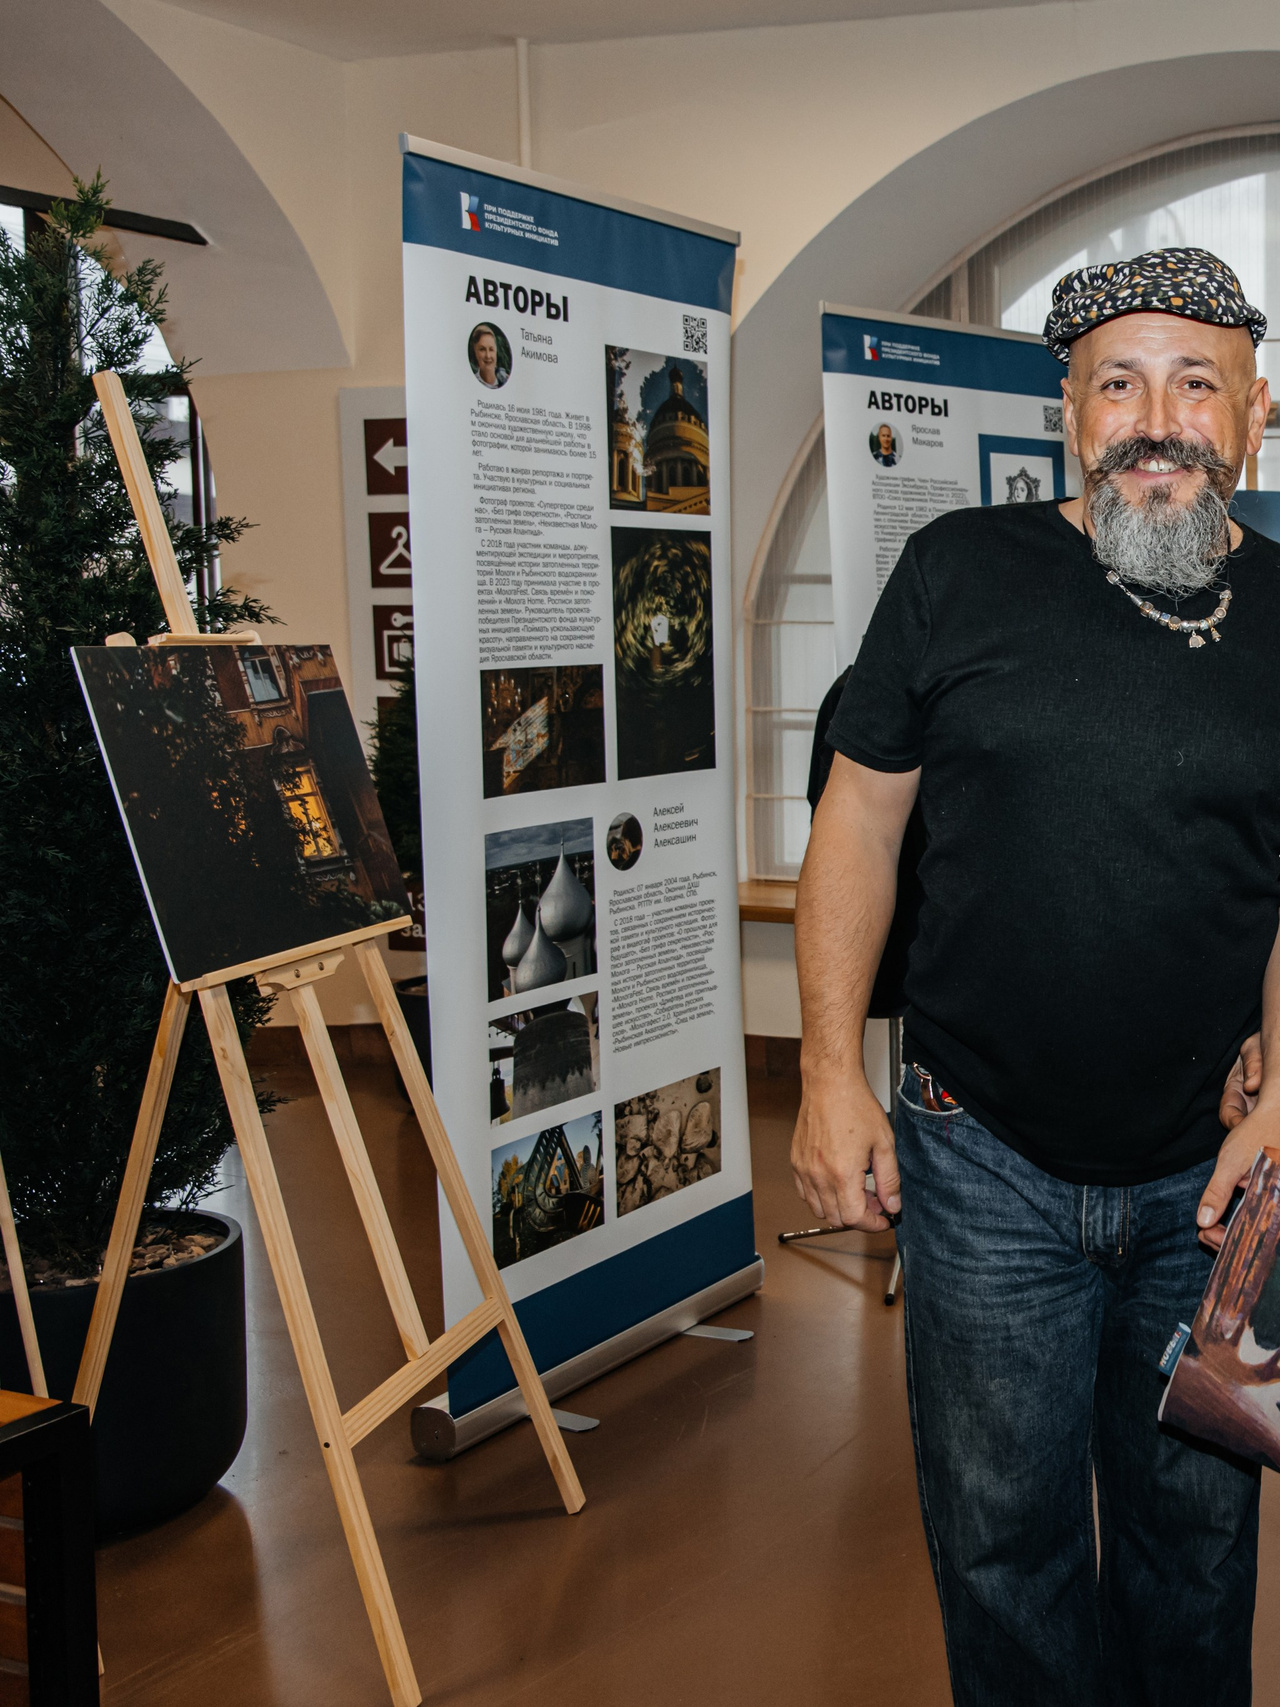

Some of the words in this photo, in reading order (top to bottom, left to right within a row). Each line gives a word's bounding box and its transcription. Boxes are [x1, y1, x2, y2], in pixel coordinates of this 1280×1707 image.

[484, 204, 496, 213] ПРИ
[498, 207, 534, 223] ПОДДЕРЖКЕ
[485, 212, 537, 232] ПРЕЗИДЕНТСКОГО
[538, 227, 558, 238] ФОНДА
[485, 222, 524, 237] КУЛЬТУРНЫХ
[525, 232, 559, 246] ИНИЦИАТИВ
[466, 275, 569, 322] АВТОРЫ
[520, 328, 552, 345] Татьяна
[521, 346, 558, 363] Акимова
[867, 390, 949, 417] АВТОРЫ
[911, 424, 941, 436] Ярослав
[912, 437, 944, 448] Макаров
[653, 803, 684, 817] Алексей
[654, 818, 699, 833] Алексеевич
[654, 833, 697, 848] Алексашин
